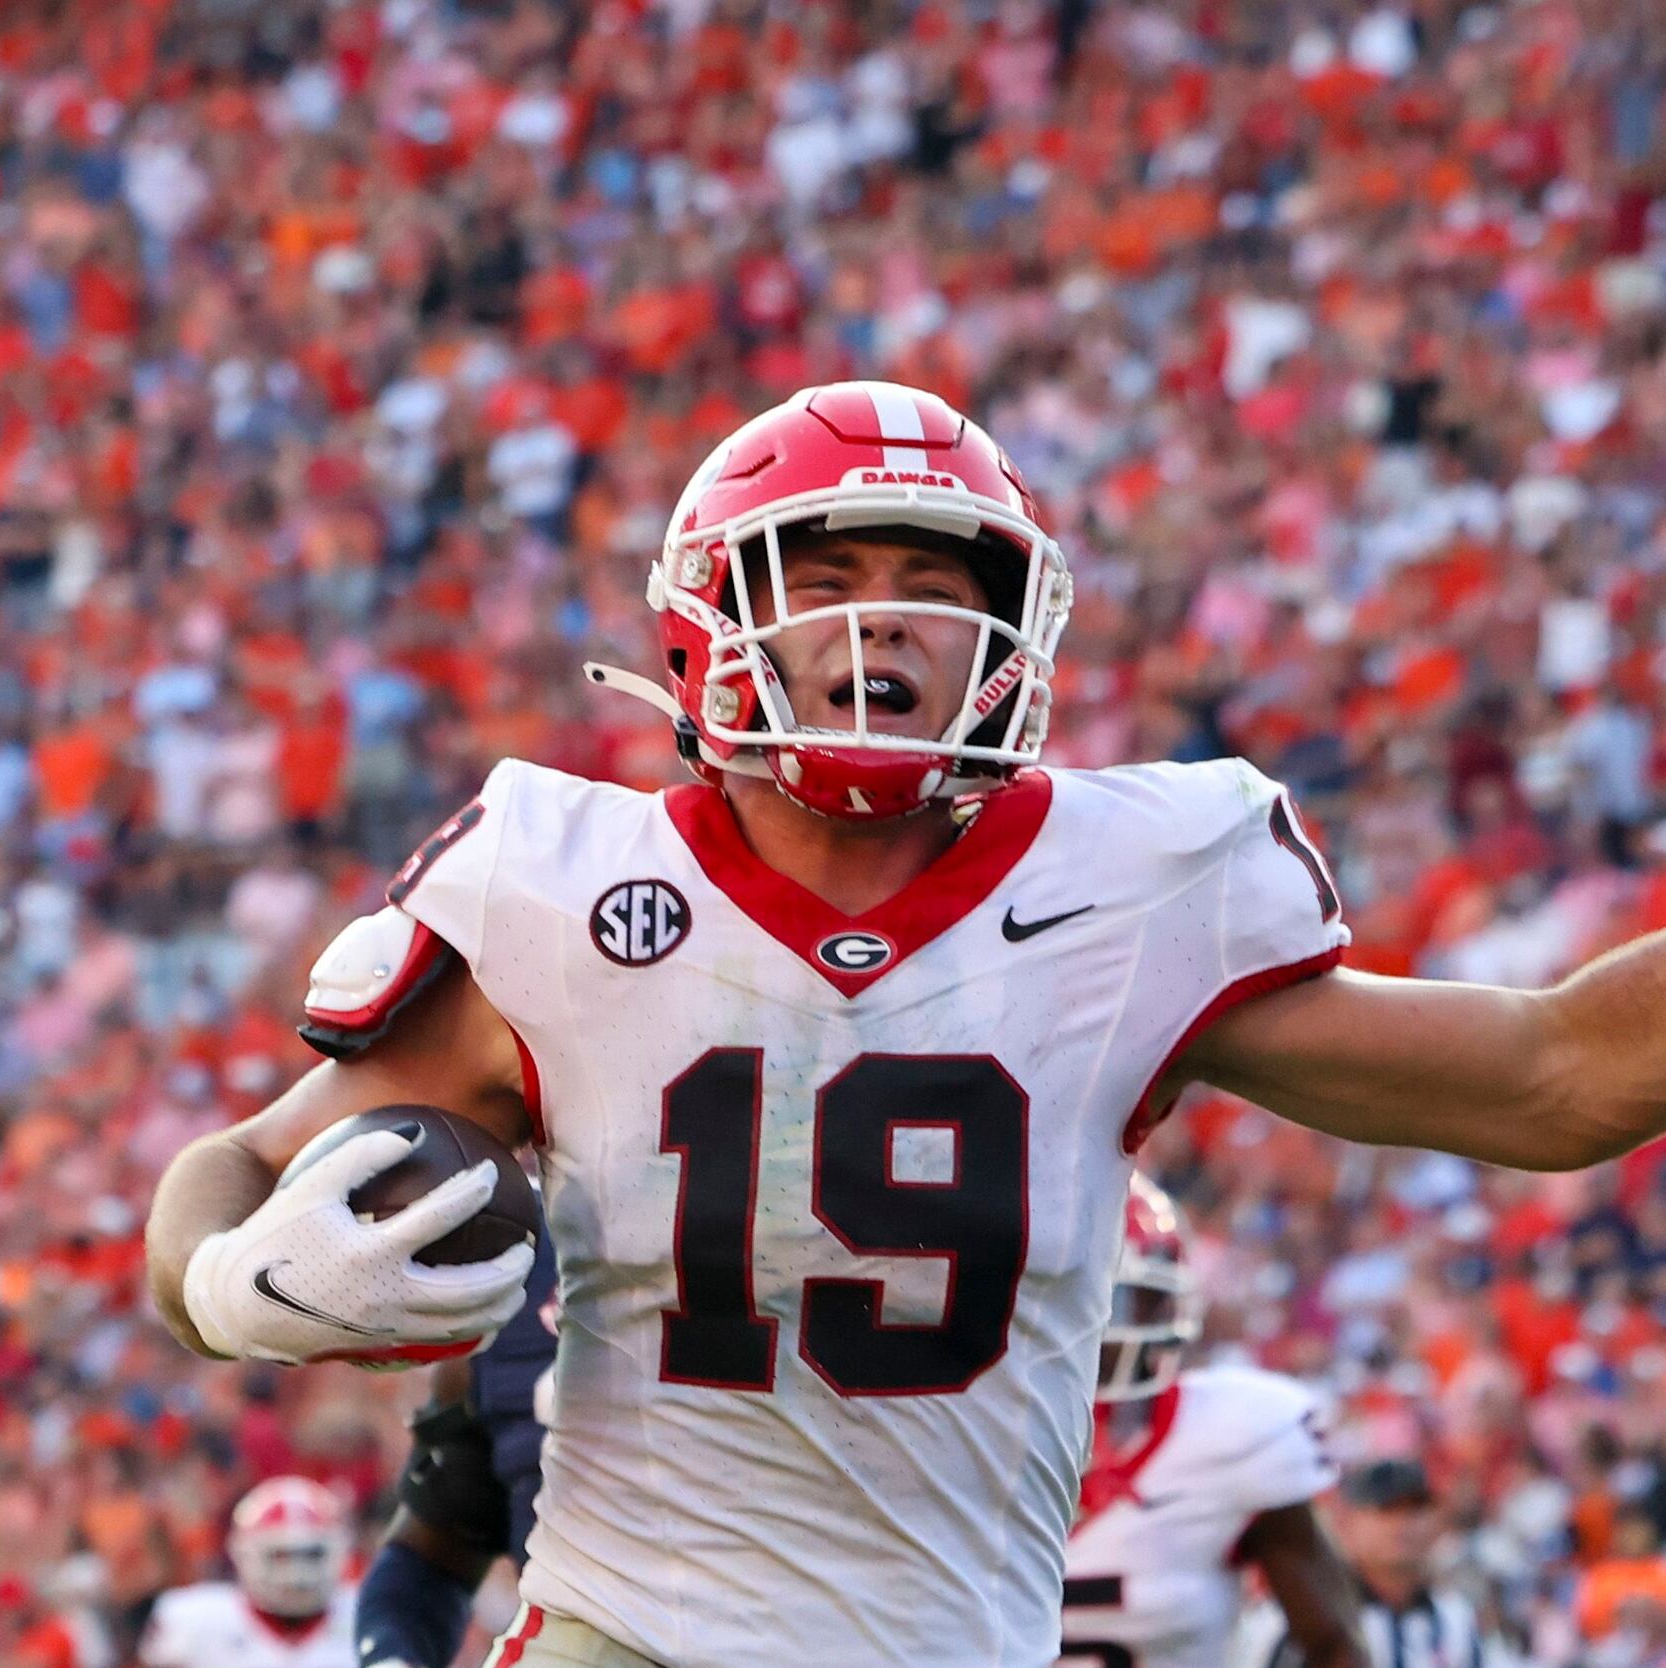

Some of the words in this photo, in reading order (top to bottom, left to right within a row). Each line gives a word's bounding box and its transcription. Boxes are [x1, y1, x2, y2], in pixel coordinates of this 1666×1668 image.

[862, 472, 954, 488] DAWGS
[596, 883, 683, 961] SEC
[658, 1046, 1031, 1398] 19
